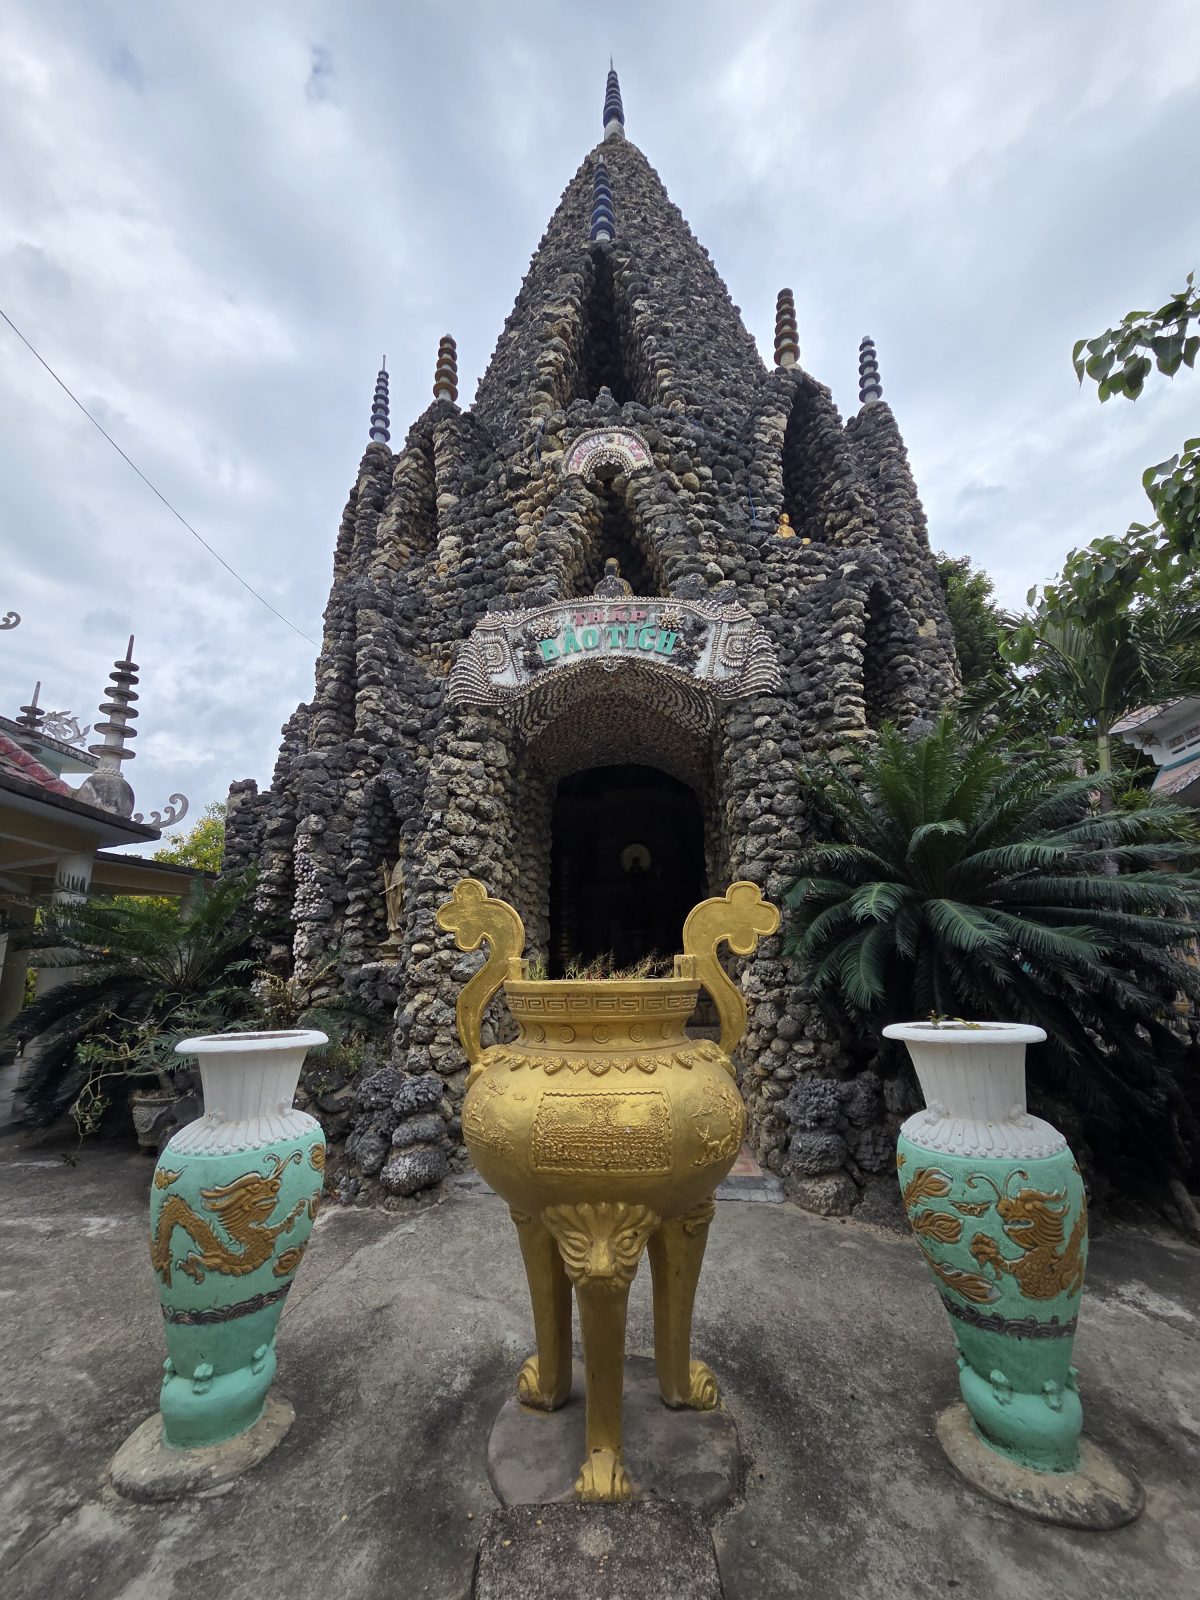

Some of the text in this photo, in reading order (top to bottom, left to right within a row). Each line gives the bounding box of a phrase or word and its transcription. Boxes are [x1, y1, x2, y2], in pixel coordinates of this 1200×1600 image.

[573, 605, 647, 626] THÁP
[539, 622, 679, 661] BẢO TÍCH
